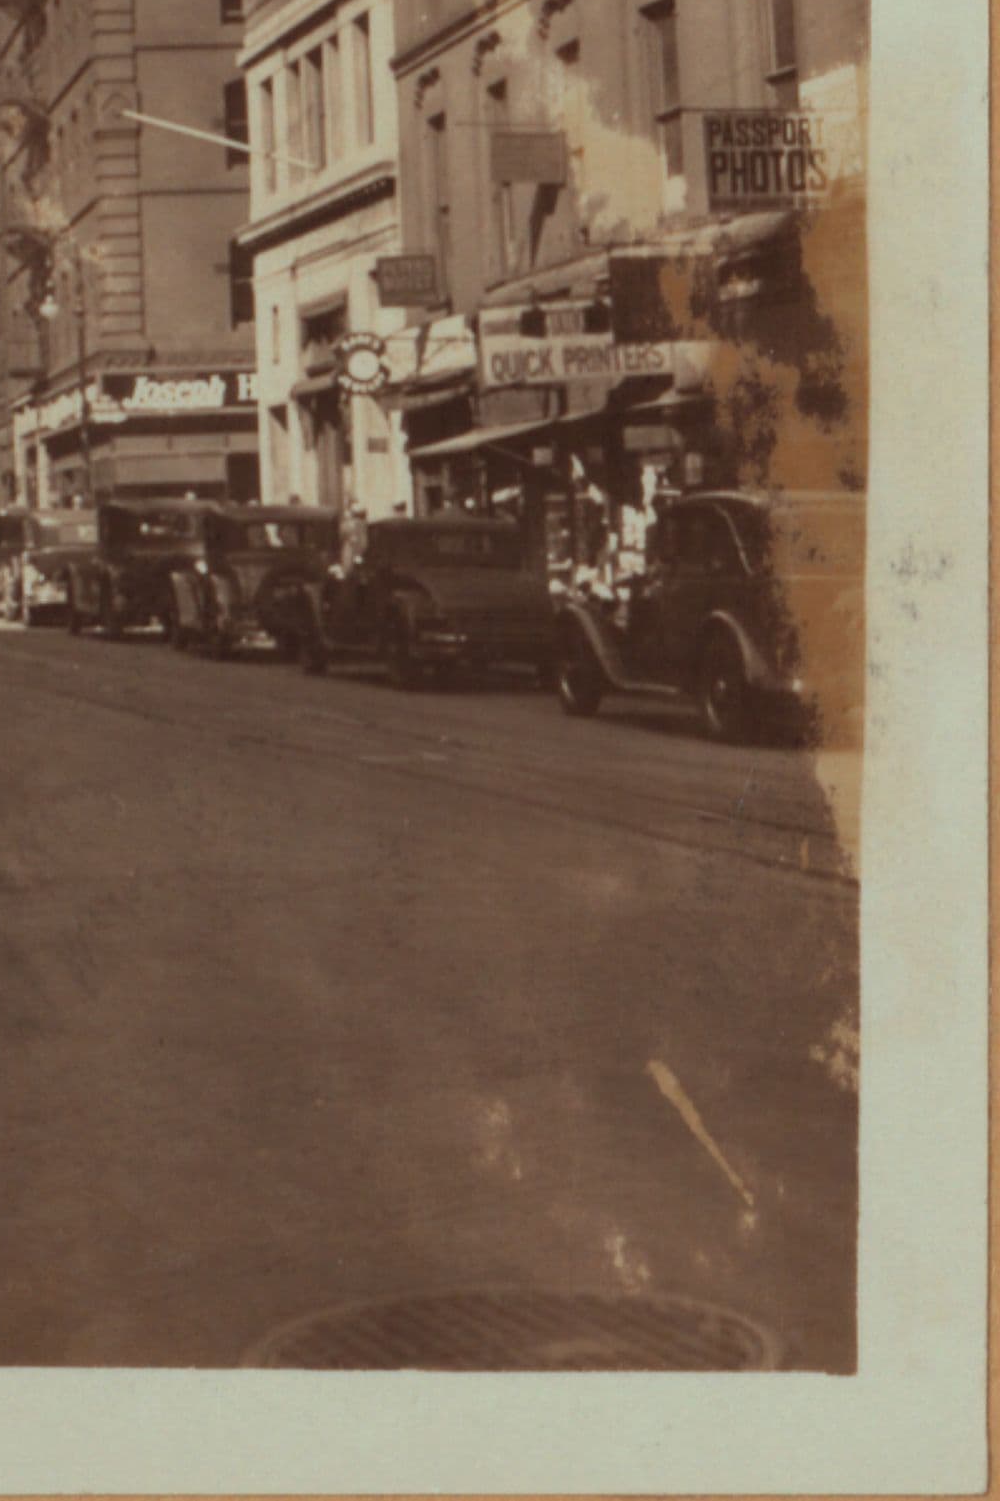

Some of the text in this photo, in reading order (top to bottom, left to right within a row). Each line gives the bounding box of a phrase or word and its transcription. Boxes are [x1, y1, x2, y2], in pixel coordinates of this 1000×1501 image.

[707, 116, 824, 146] PASSPORT
[711, 150, 828, 193] PHOTOS
[491, 344, 663, 381] QUICK PRINTERS
